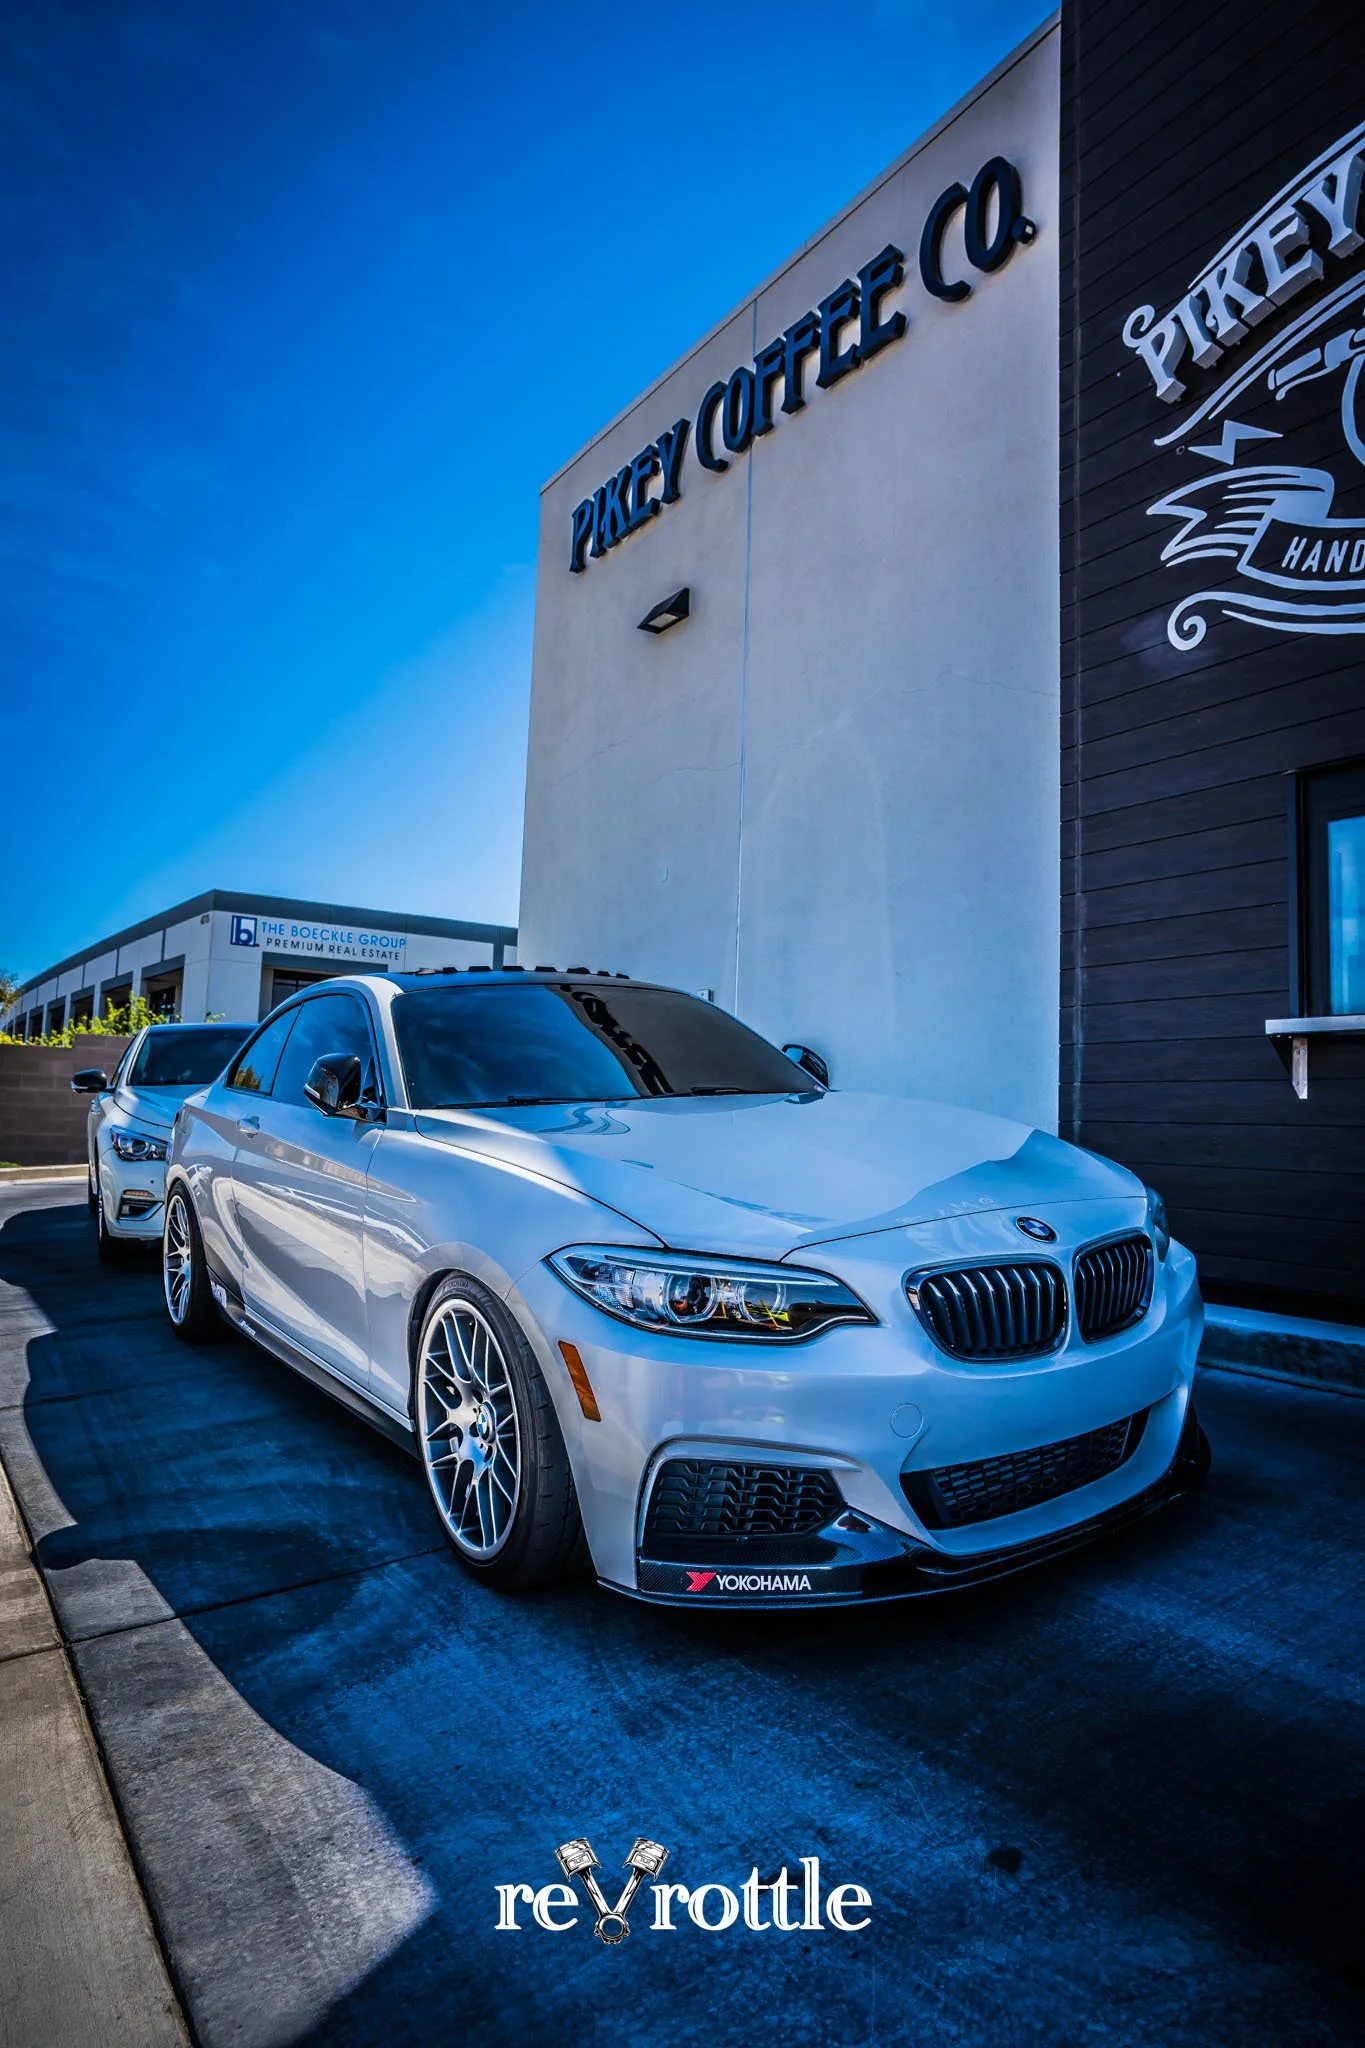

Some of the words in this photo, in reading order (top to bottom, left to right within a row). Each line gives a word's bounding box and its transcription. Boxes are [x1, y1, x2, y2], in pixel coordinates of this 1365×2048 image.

[1123, 152, 1365, 404] PIKEY
[570, 417, 691, 573] PIKEY
[695, 243, 908, 473] COFFEE
[919, 156, 1036, 301] CO.
[261, 921, 285, 936] THE
[290, 925, 353, 943] BOECKLE
[359, 933, 407, 948] GROUP
[266, 937, 324, 952] PREMIUM
[328, 944, 357, 956] REAL
[361, 948, 400, 960] ESTATE
[716, 1574, 812, 1591] YOKOHAMA
